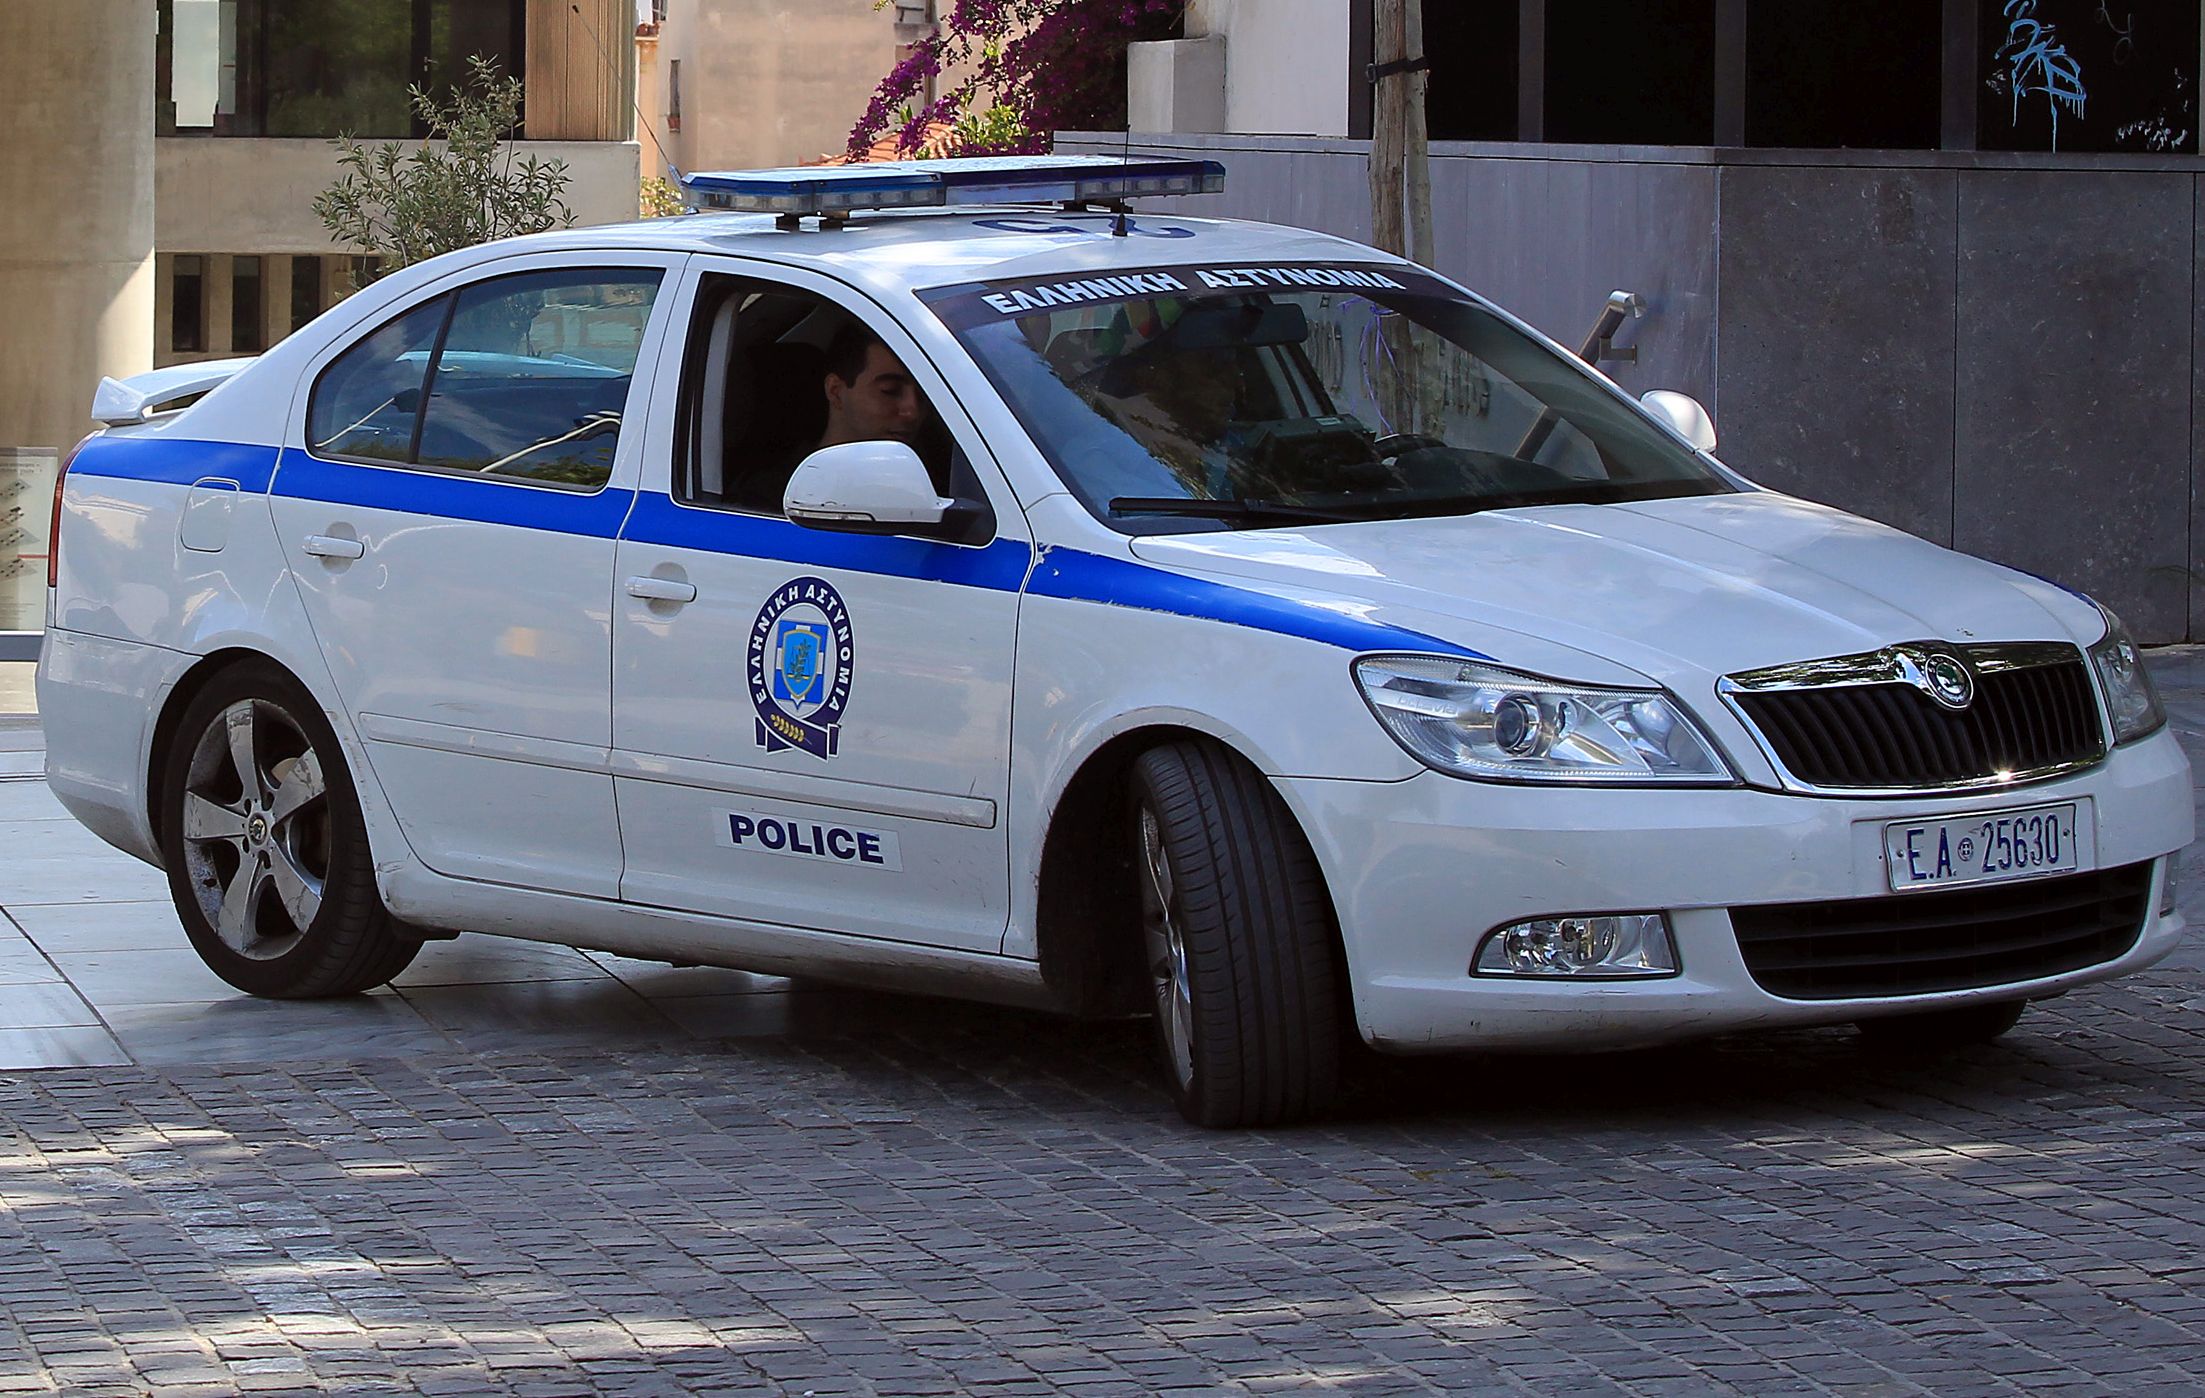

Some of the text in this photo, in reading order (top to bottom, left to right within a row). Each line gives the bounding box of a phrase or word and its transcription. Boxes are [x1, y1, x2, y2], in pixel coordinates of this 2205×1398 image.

[980, 267, 1407, 315] ΕΛΛΗΝΙΚΗ ΑΣΤΥΝΟΜΙΑ
[751, 584, 851, 713] ΕΛΛΗΝΙΚΗ ΑΣΤΥΝΟΜΙΑ
[728, 813, 885, 865] POLICE
[1981, 813, 2060, 874] 25630
